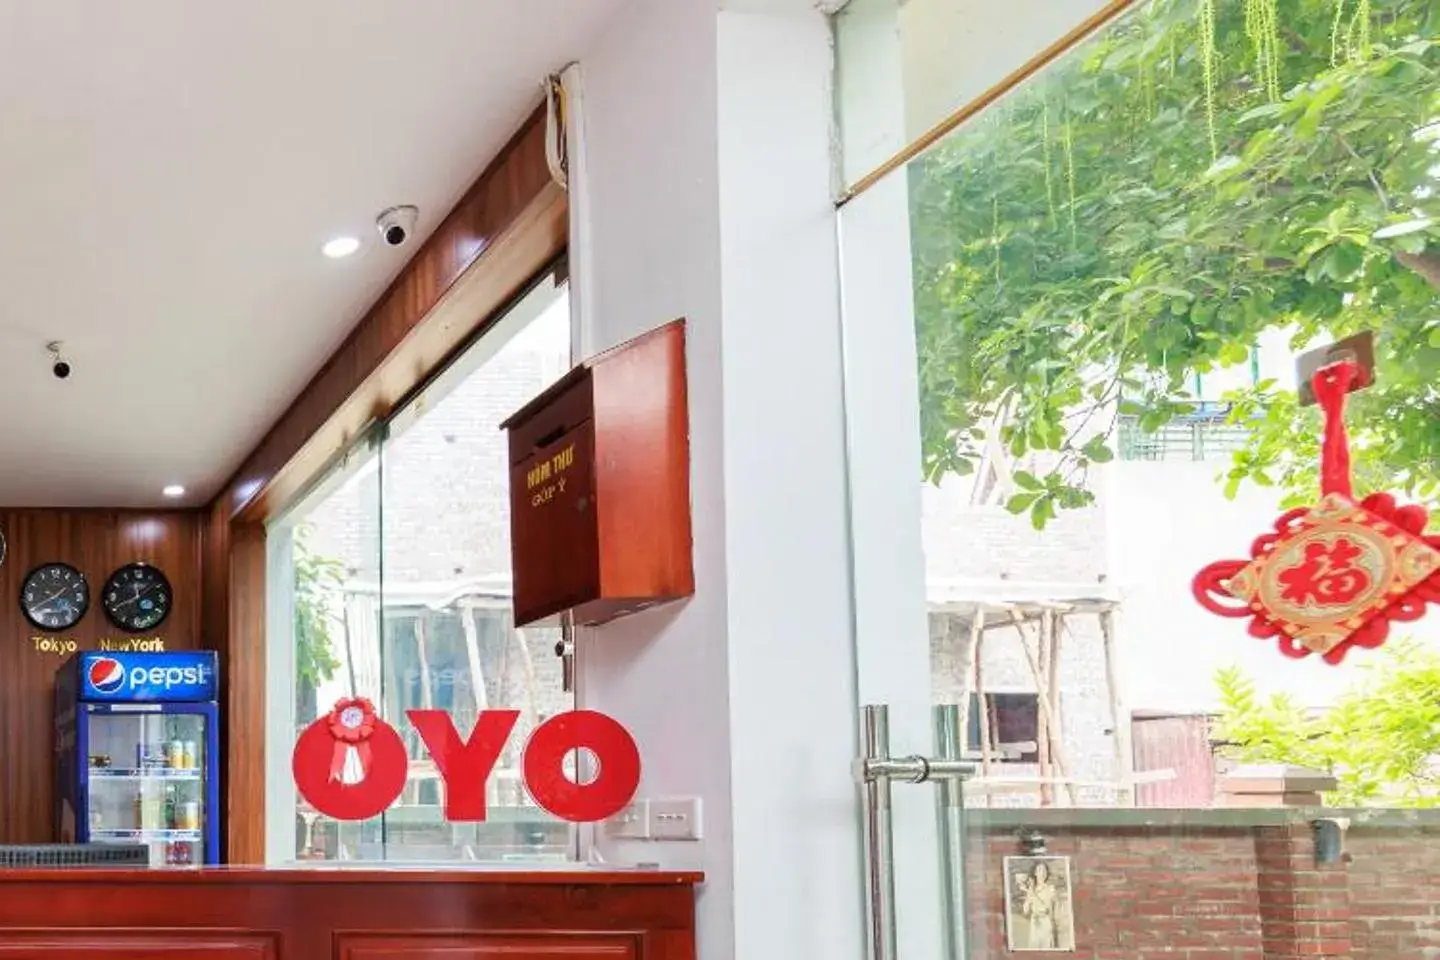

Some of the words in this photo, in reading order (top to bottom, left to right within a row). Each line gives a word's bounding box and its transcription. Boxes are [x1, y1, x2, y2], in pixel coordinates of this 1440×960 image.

[1277, 538, 1371, 606] 福
[32, 636, 78, 655] Tokyo
[129, 663, 205, 690] pepsi
[293, 709, 641, 823] OYO
